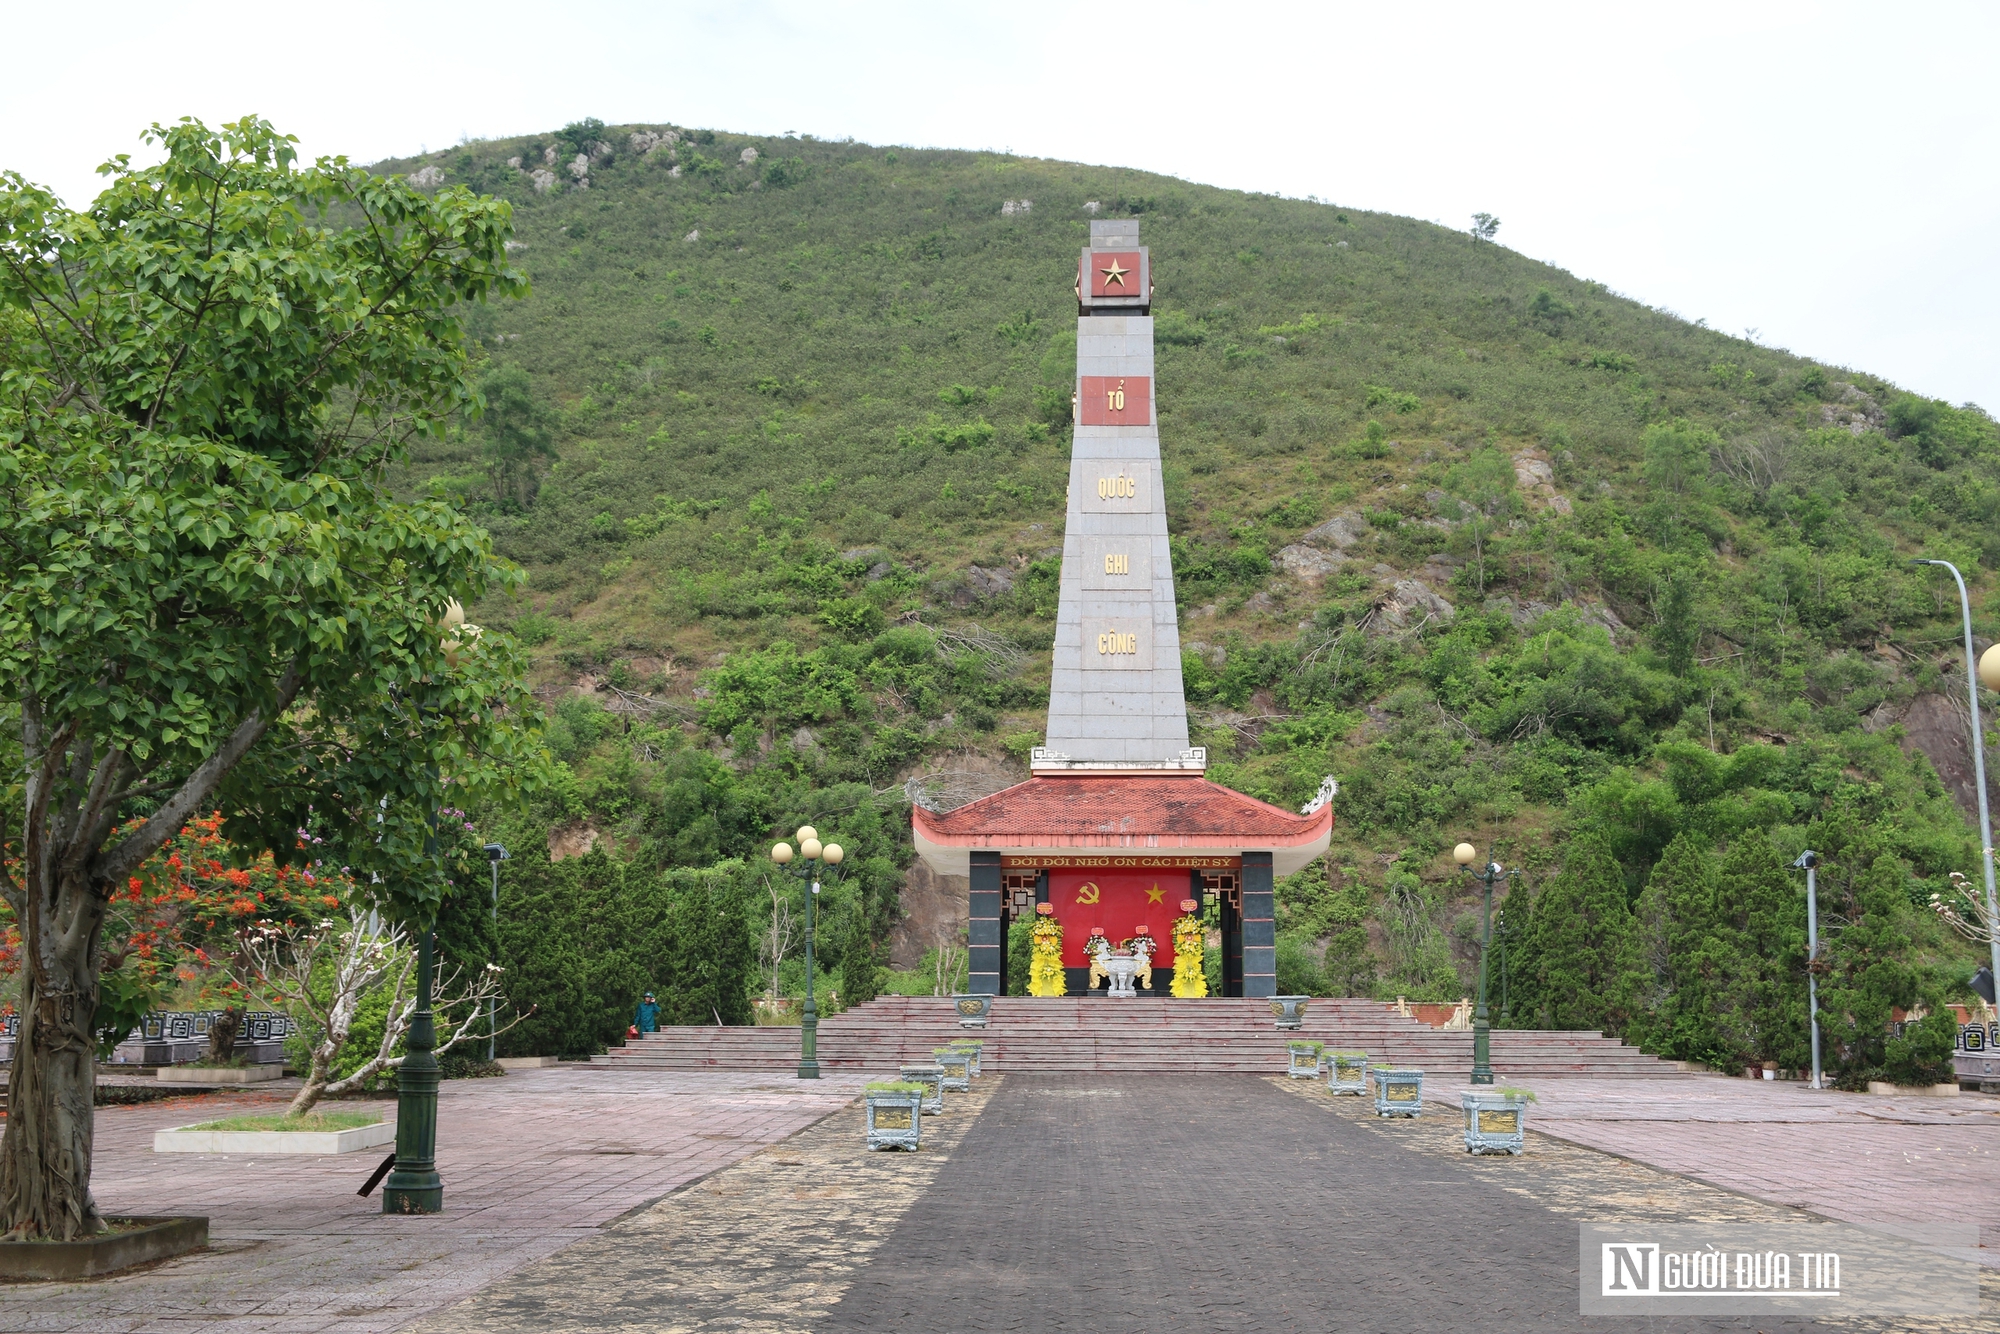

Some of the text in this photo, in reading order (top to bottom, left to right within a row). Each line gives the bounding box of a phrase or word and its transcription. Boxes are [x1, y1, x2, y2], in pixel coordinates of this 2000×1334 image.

[1107, 379, 1125, 411] TỔ
[1105, 554, 1128, 575] GHI
[1098, 628, 1136, 655] CÔNG
[1010, 855, 1039, 866] ĐỜI
[1042, 855, 1071, 866] ĐỜI
[1074, 855, 1110, 866] NHỚ
[1114, 857, 1137, 866] ƠN
[1141, 855, 1171, 866] CÁC
[1175, 856, 1210, 867] LIỆT
